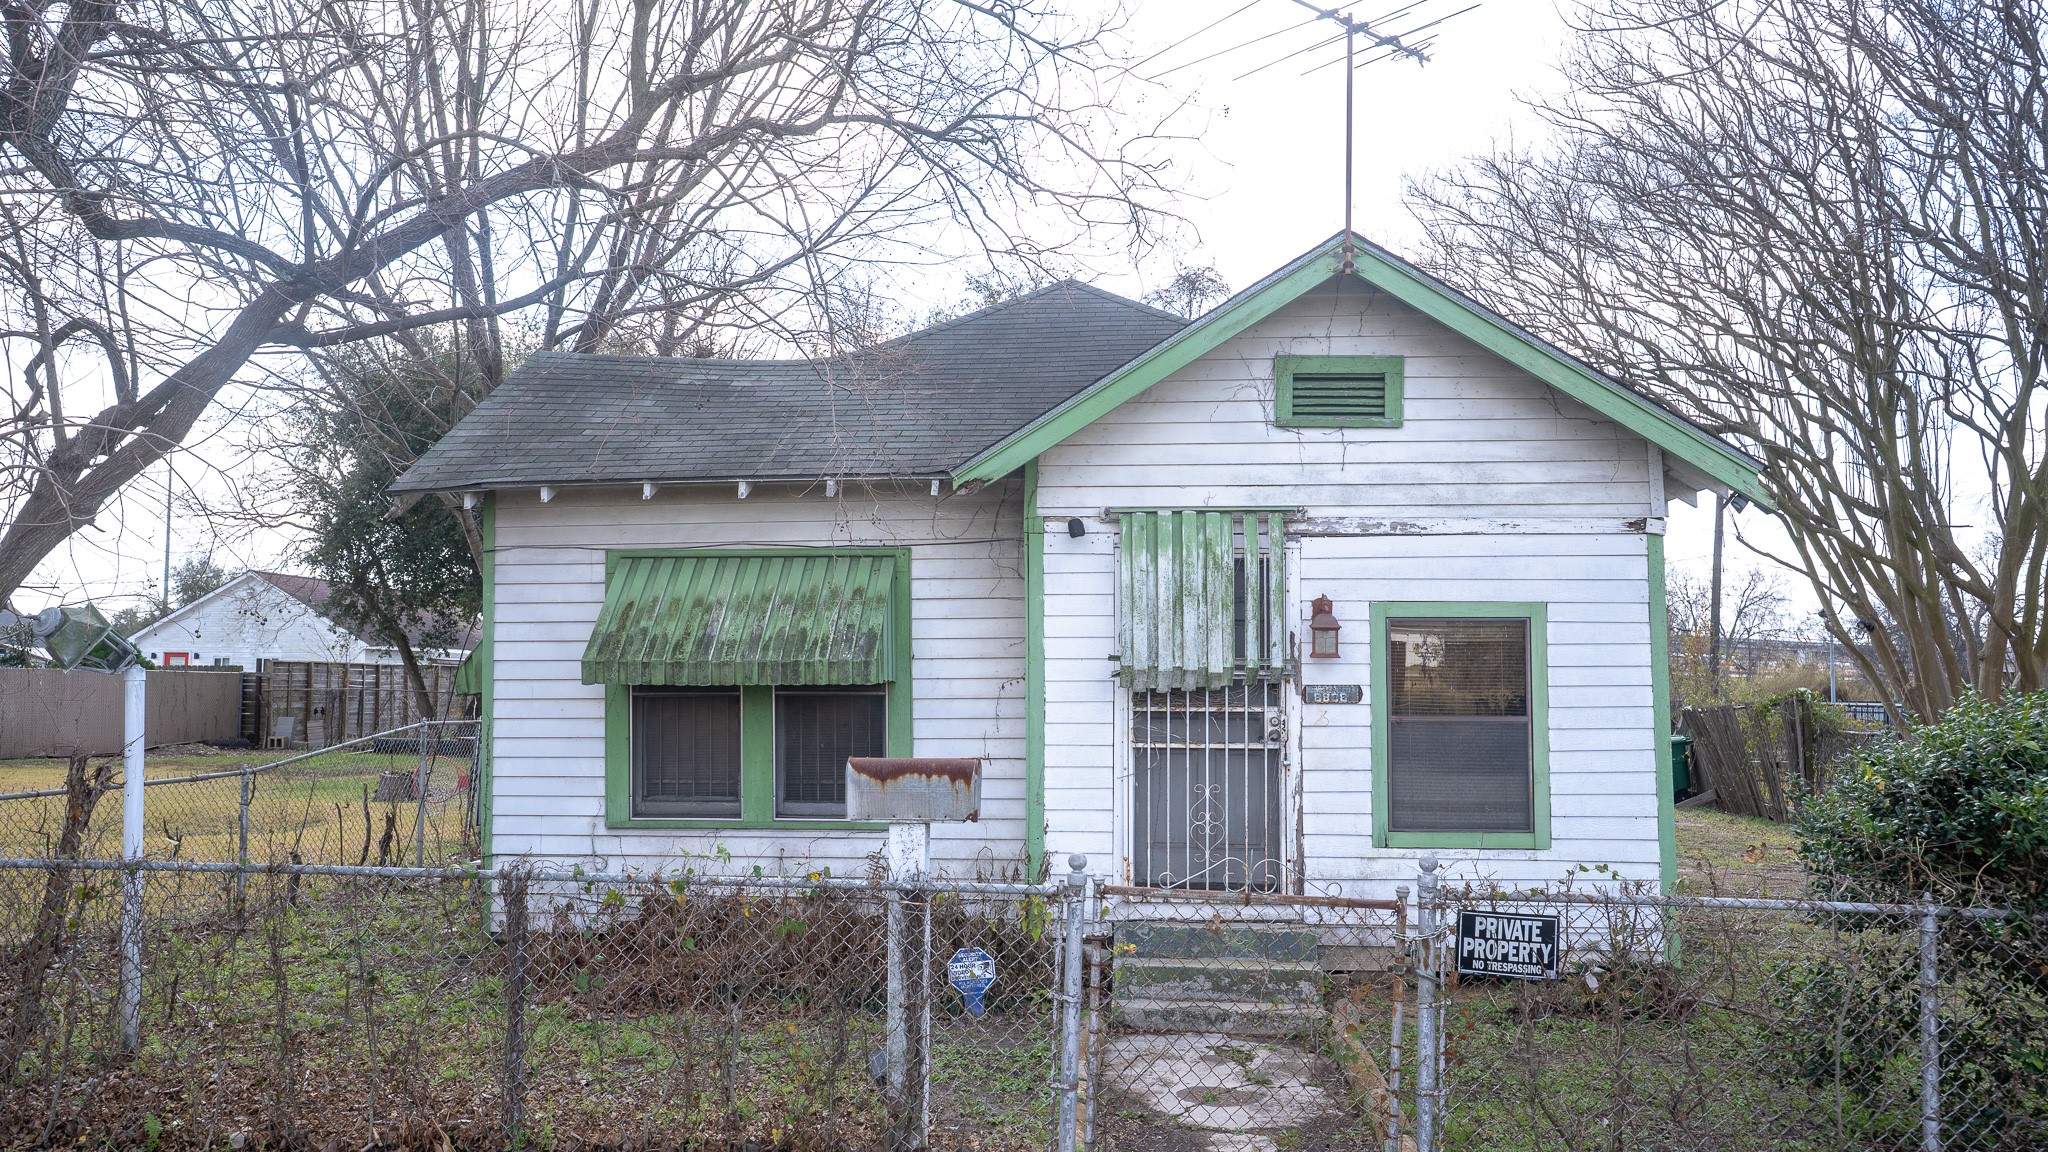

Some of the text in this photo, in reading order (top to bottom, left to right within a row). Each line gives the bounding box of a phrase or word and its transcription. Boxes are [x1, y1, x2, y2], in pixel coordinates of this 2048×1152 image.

[1474, 916, 1543, 942] PRIVATE
[1463, 937, 1552, 964] PROPERTY
[1472, 960, 1542, 975] NO TRESPASSING
